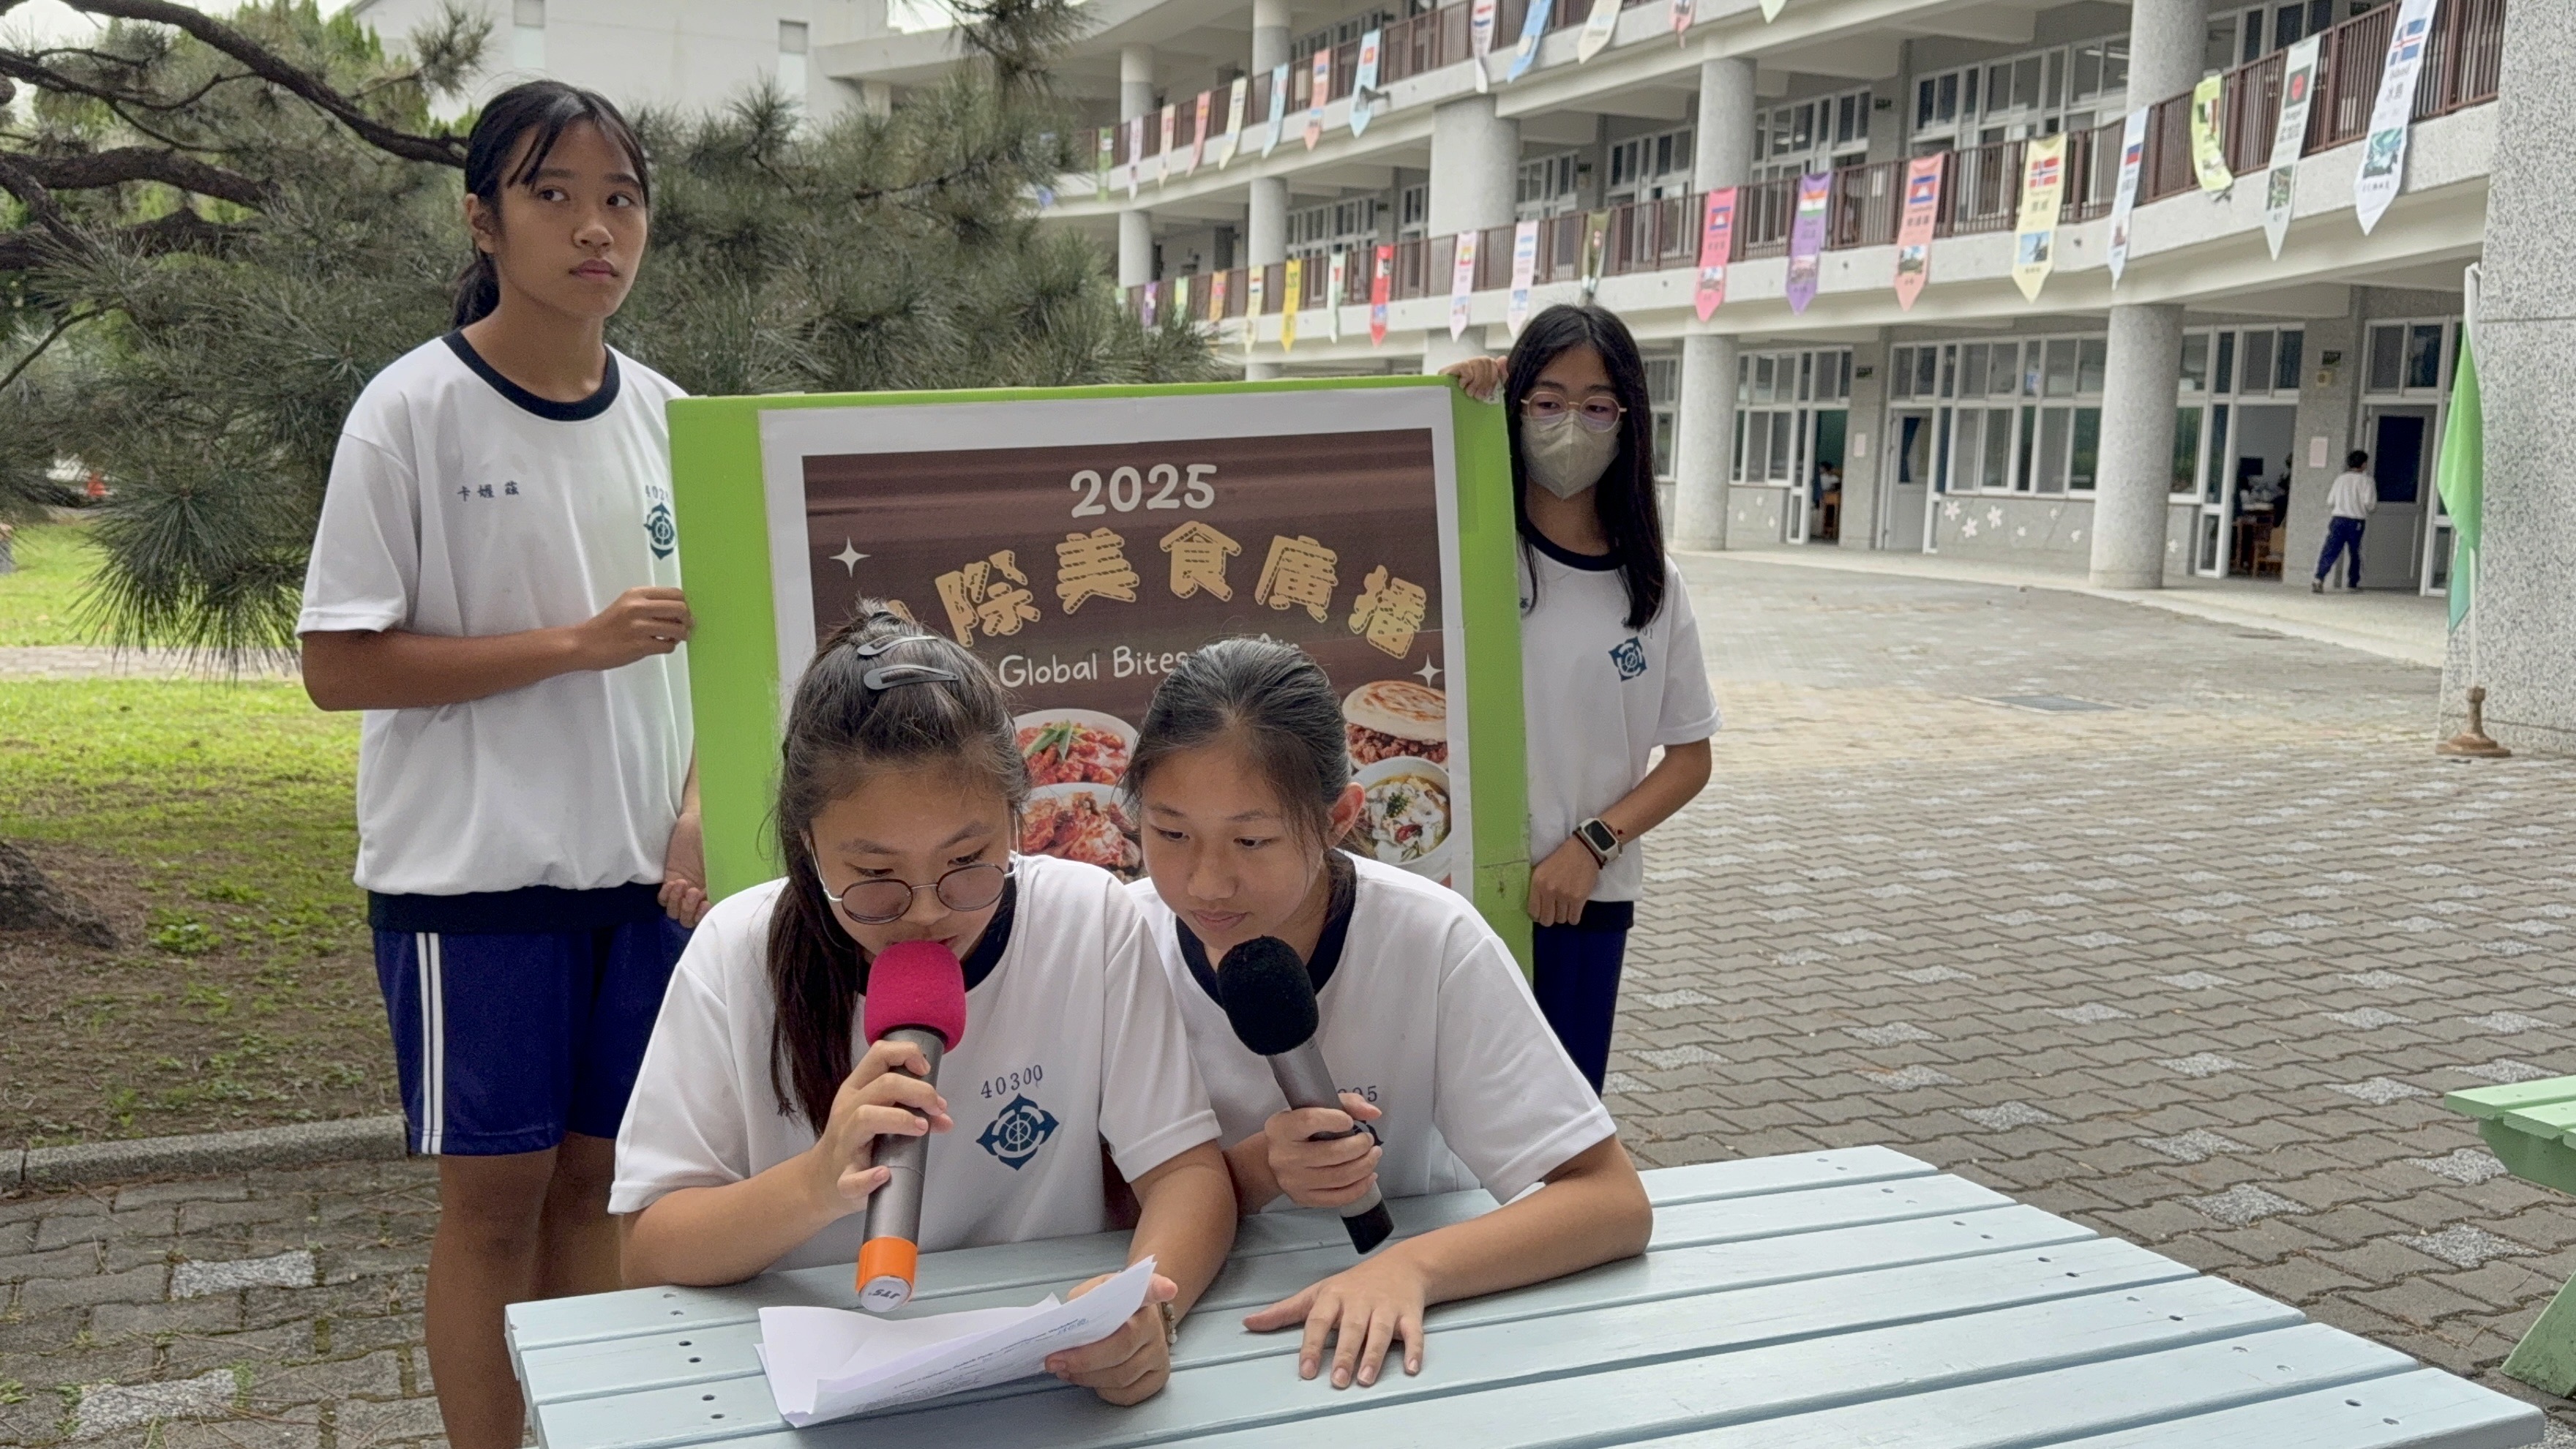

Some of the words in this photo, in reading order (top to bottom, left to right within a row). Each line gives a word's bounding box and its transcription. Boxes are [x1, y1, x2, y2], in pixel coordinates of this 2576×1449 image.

[1070, 464, 1217, 518] 2025
[887, 520, 1427, 659] 際美食廣播
[998, 653, 1097, 688] Global
[981, 1065, 1043, 1098] 40300
